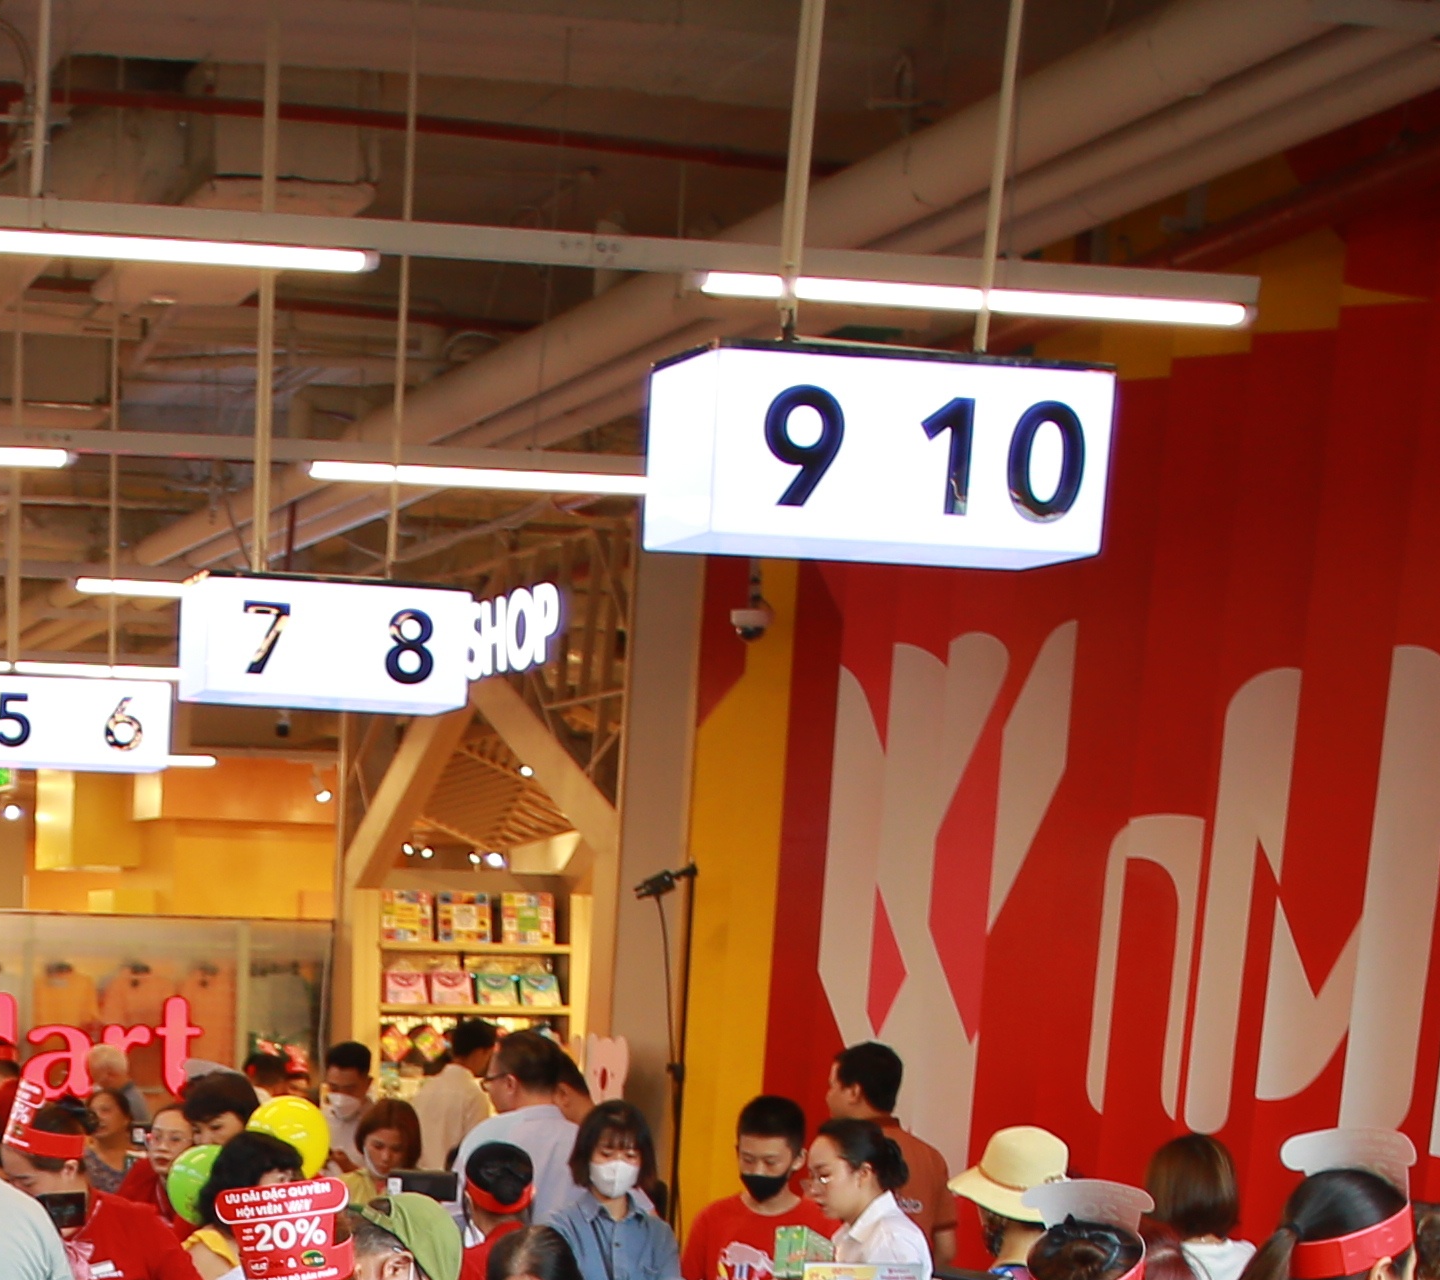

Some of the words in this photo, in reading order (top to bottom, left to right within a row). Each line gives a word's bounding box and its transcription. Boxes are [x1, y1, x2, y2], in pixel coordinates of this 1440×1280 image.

[763, 384, 845, 508] 9
[920, 397, 1087, 524] 10
[241, 600, 291, 675] 7
[382, 609, 436, 684] 8
[465, 582, 560, 680] SHOP
[103, 696, 143, 752] 6
[254, 1215, 328, 1252] 20%
